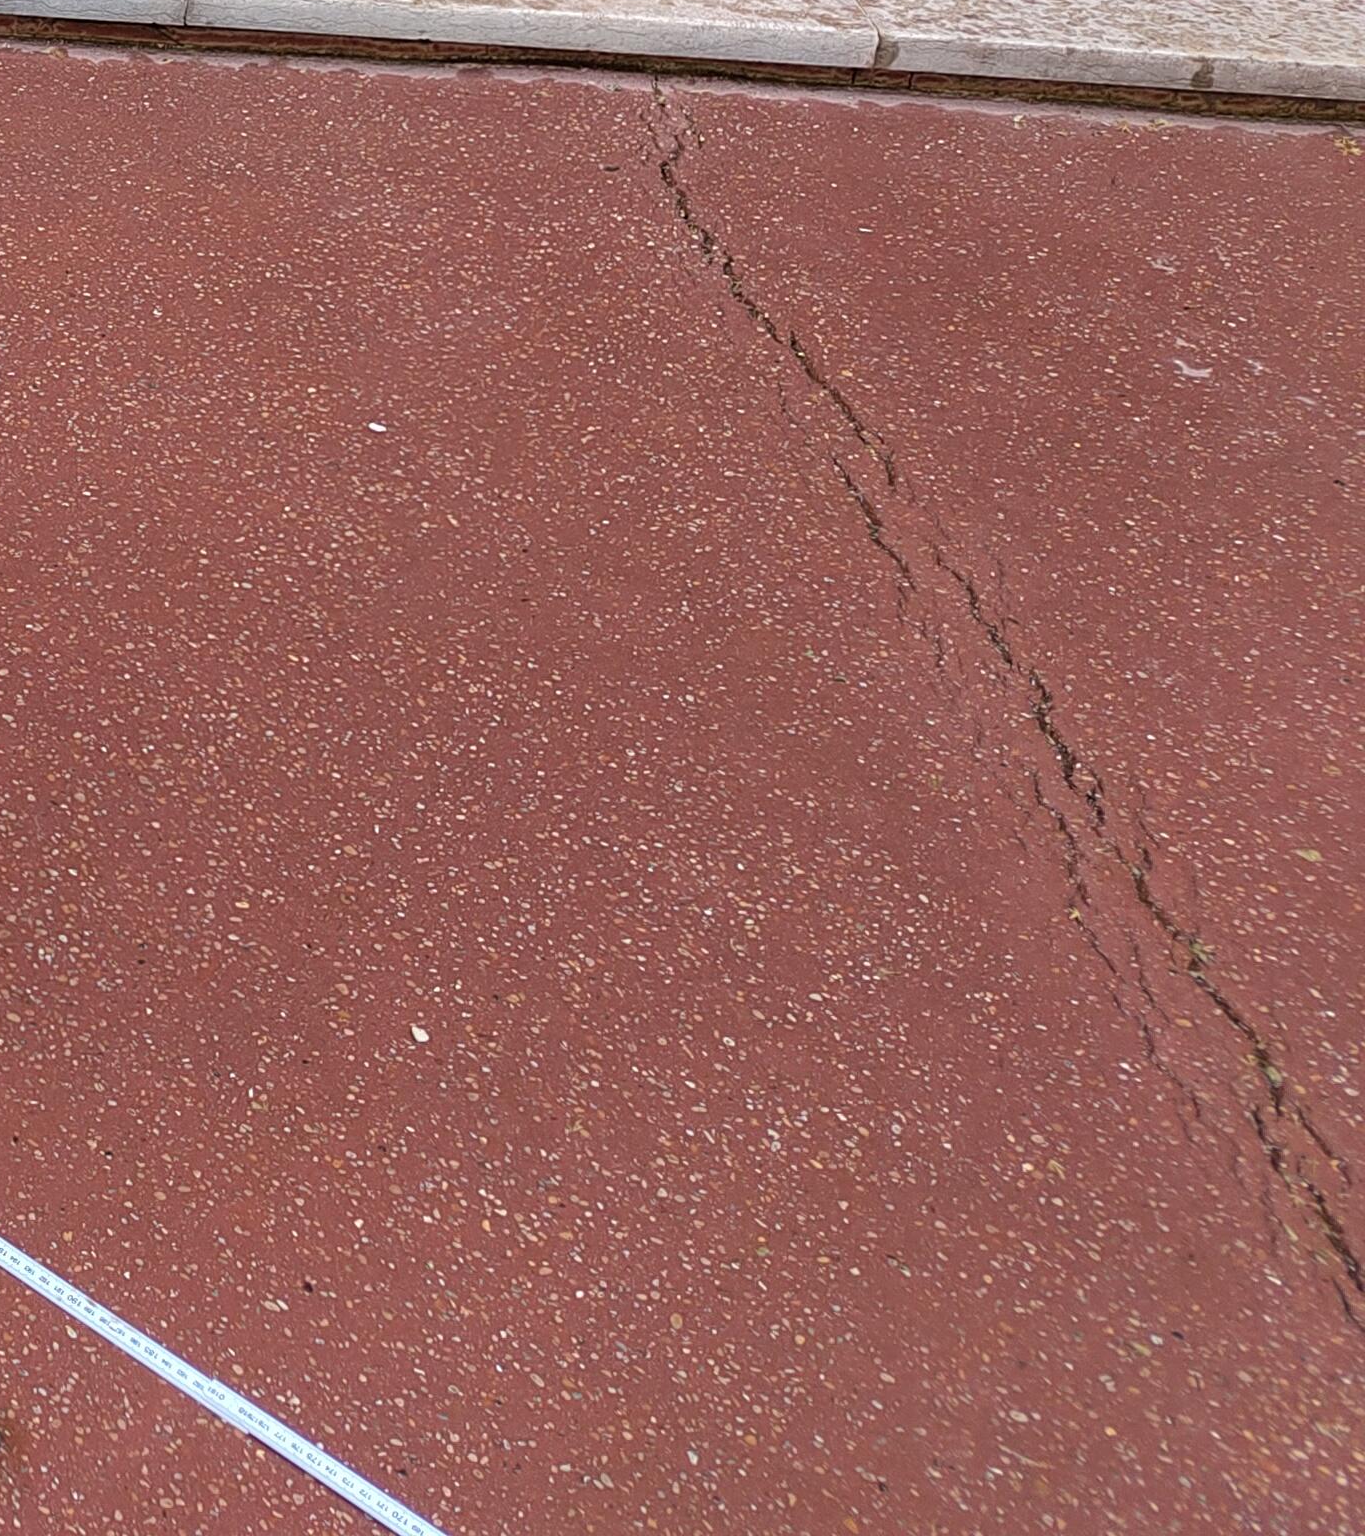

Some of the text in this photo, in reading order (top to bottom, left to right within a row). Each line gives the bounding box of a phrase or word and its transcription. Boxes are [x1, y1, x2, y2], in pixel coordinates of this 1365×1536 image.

[66, 1294, 82, 1307] 190
[324, 1465, 337, 1476] 174
[391, 1510, 408, 1524] 170
